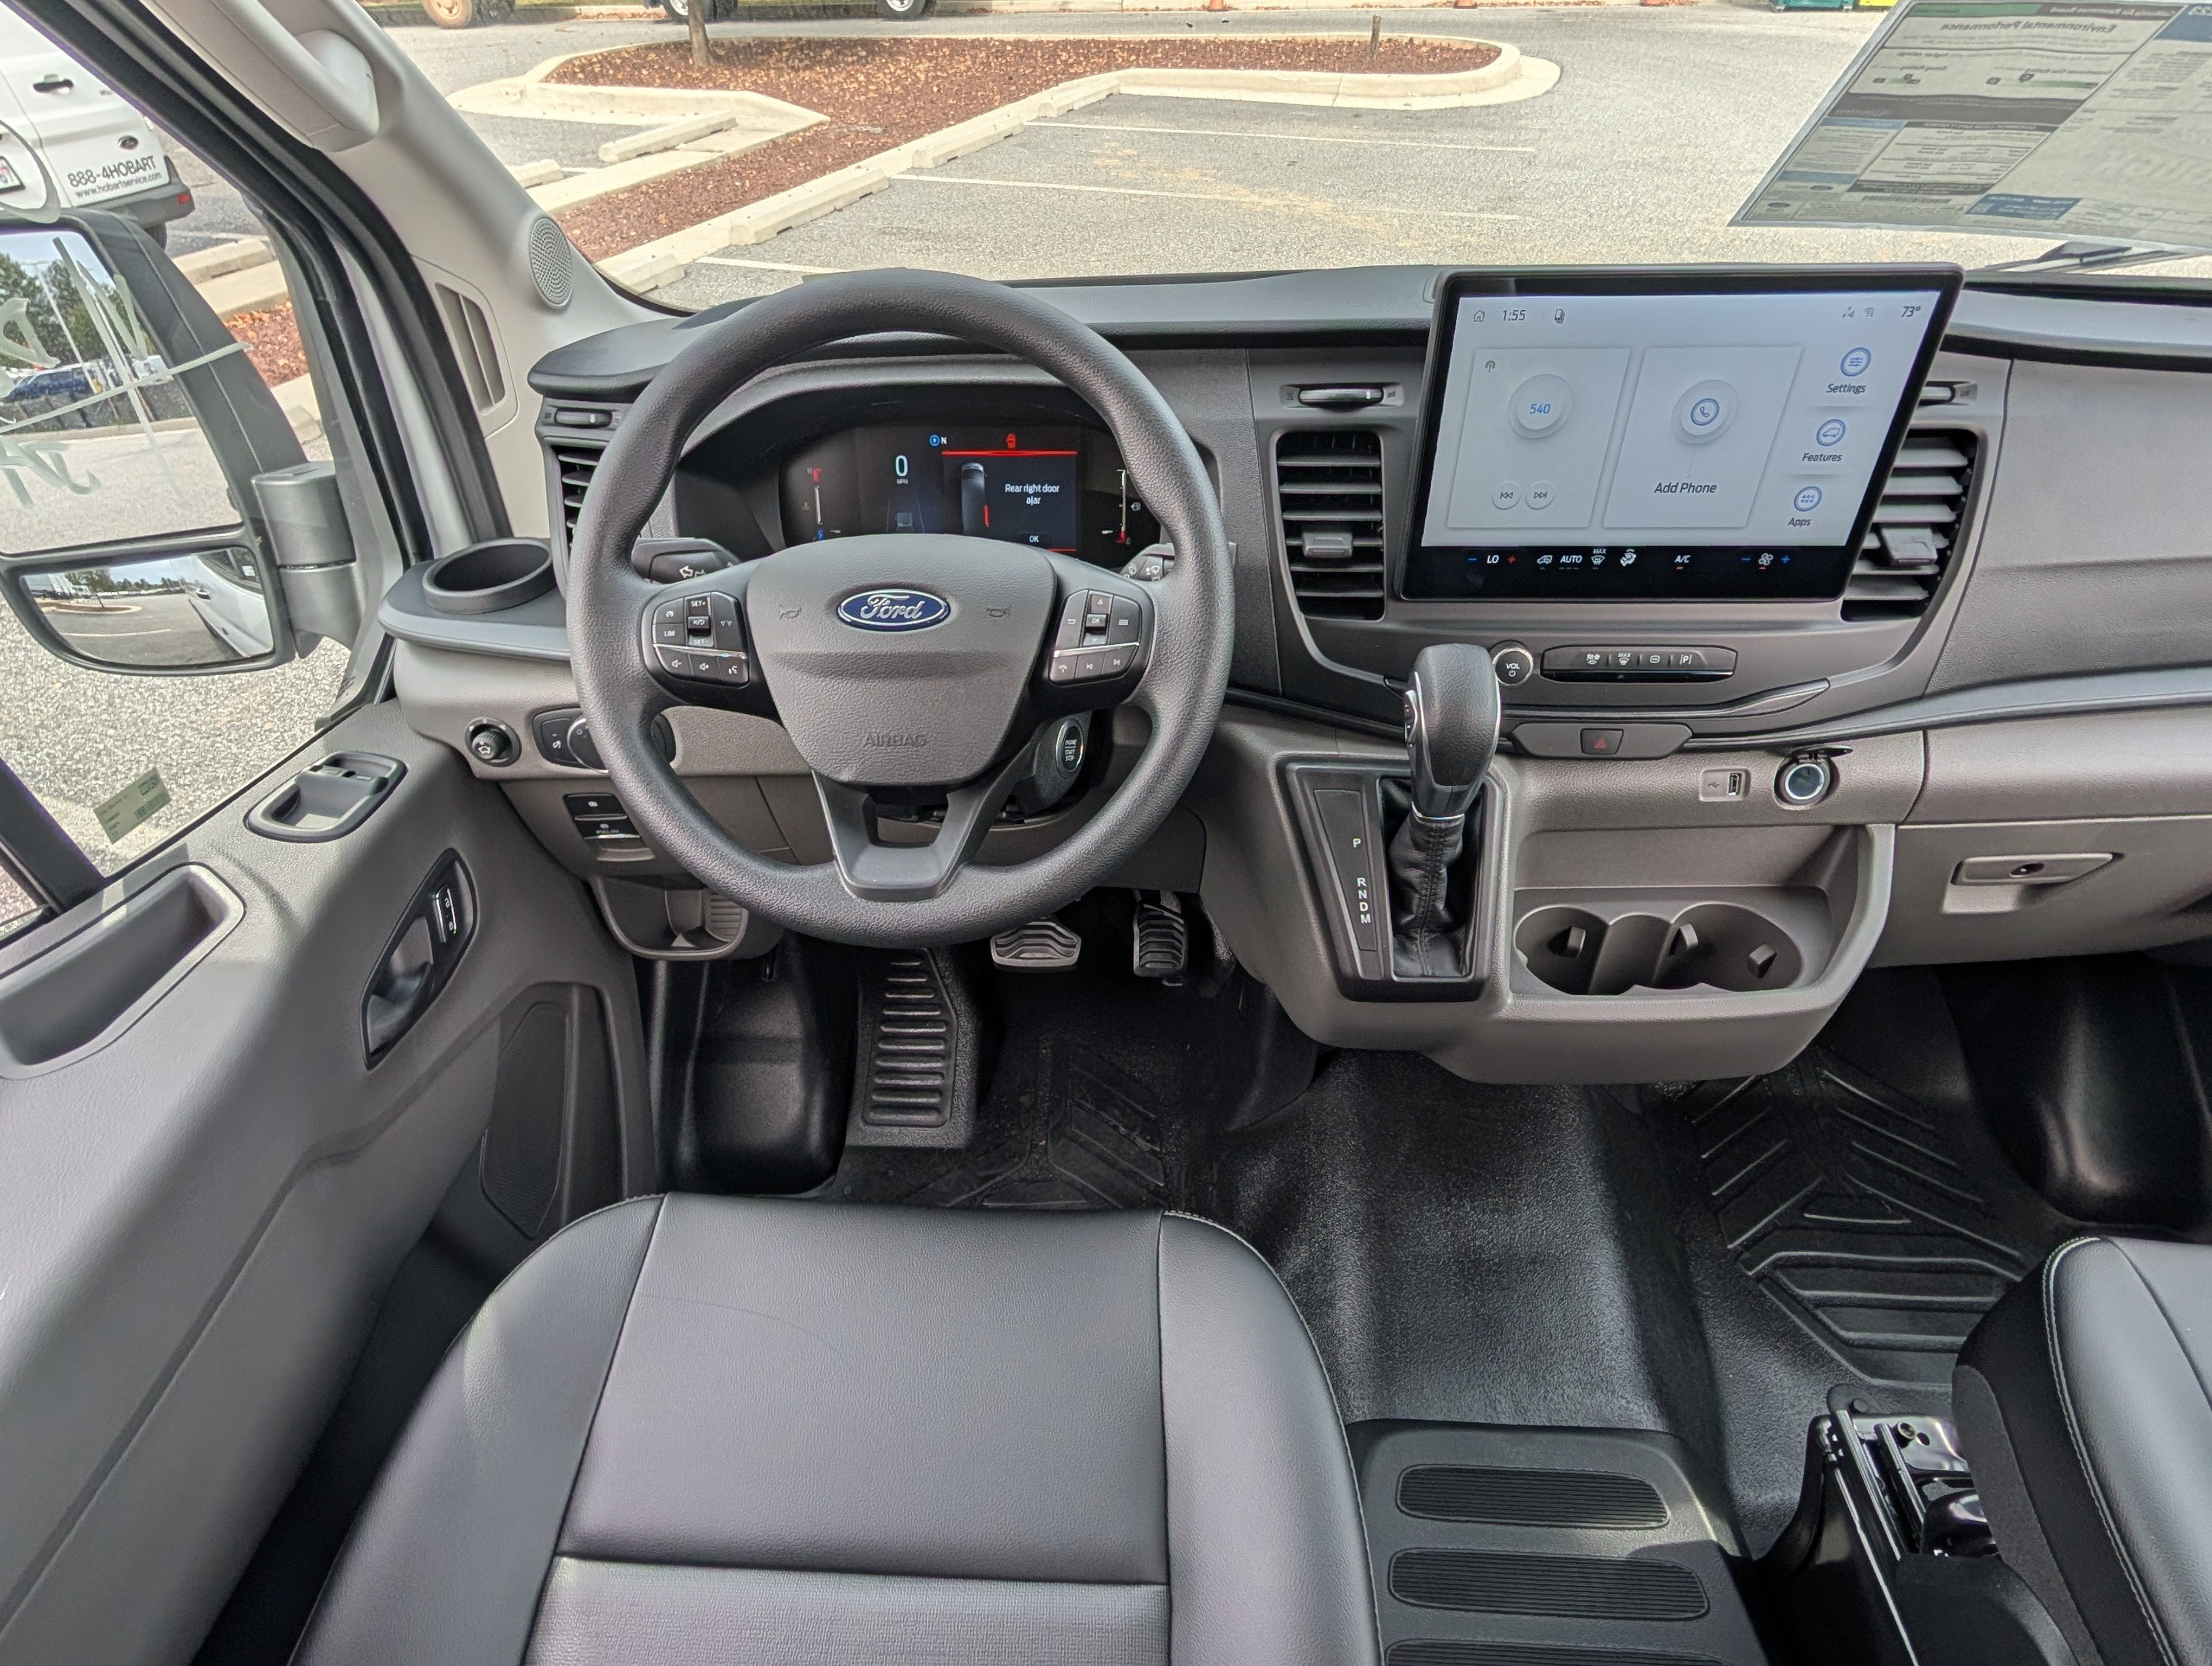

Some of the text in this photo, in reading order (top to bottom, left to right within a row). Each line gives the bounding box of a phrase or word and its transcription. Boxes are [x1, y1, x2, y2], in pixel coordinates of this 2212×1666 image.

[67, 155, 157, 188] 888-4HOBART
[75, 171, 162, 198] www.hobartservice.com
[1502, 310, 1526, 321] 1:55
[1901, 306, 1921, 318] 73°
[1826, 383, 1866, 395] Settings
[1529, 403, 1551, 415] 540
[1802, 452, 1842, 463] Features
[895, 454, 908, 477] 0
[1005, 484, 1060, 494] Rear right door
[1654, 483, 1717, 494] Add Phone
[1026, 496, 1041, 506] ajar
[1787, 517, 1811, 528] Apps
[1029, 535, 1039, 543] OK
[1487, 555, 1499, 564] LO
[1560, 555, 1583, 563] AUTO
[1674, 555, 1691, 563] A/C
[860, 595, 925, 619] Ford
[864, 734, 927, 746] AIRBAG
[1353, 838, 1361, 848] P
[1357, 877, 1367, 887] R
[1358, 889, 1367, 900] N
[1359, 902, 1368, 912] D
[1360, 913, 1371, 924] M
